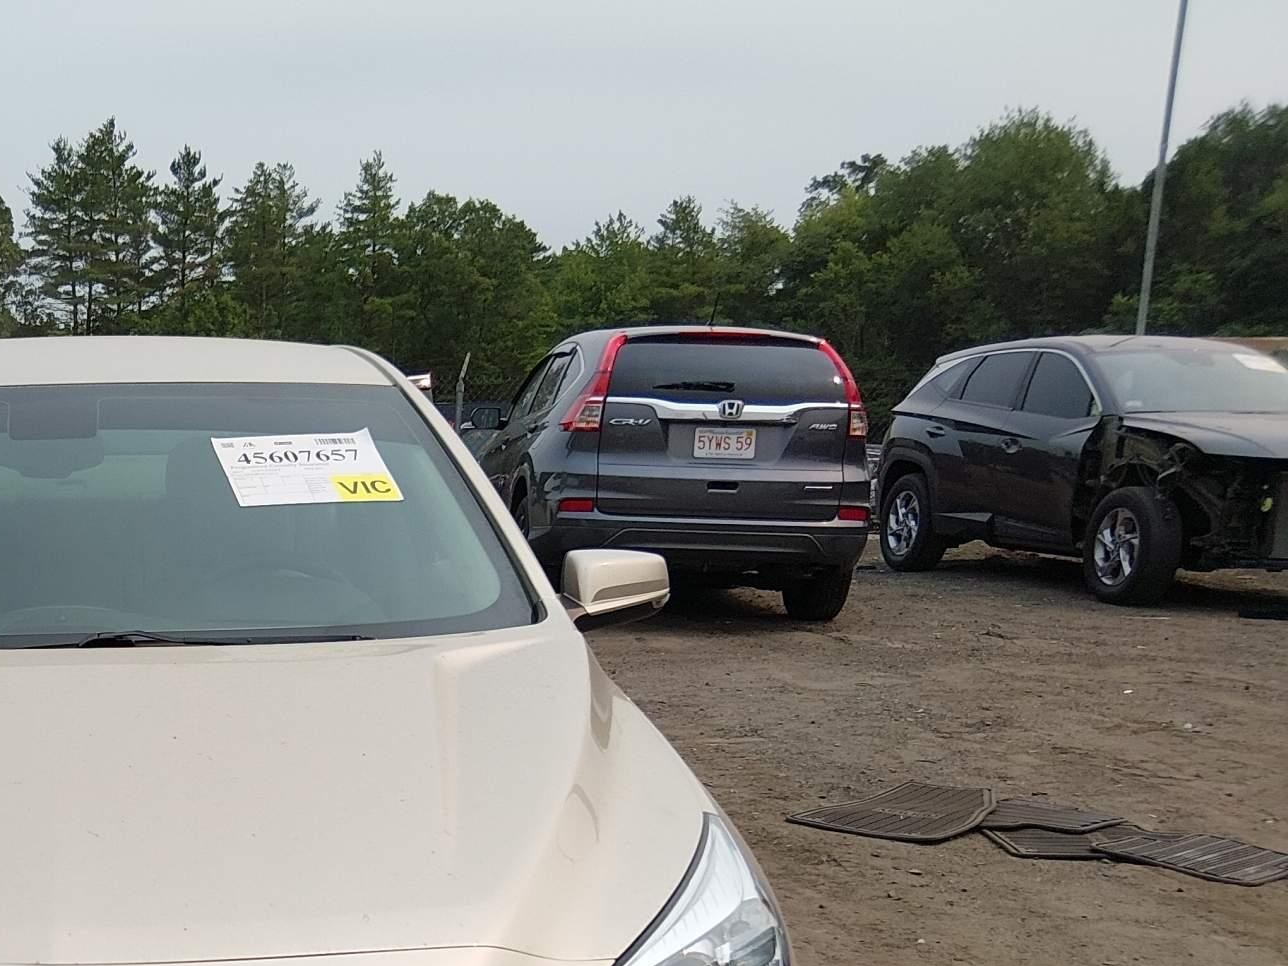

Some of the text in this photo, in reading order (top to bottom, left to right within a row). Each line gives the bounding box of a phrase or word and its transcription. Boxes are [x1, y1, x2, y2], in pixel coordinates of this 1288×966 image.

[608, 418, 652, 426] CR-V
[697, 435, 753, 452] 5YWS 59
[237, 448, 358, 465] 45607657
[338, 479, 392, 495] VIC
